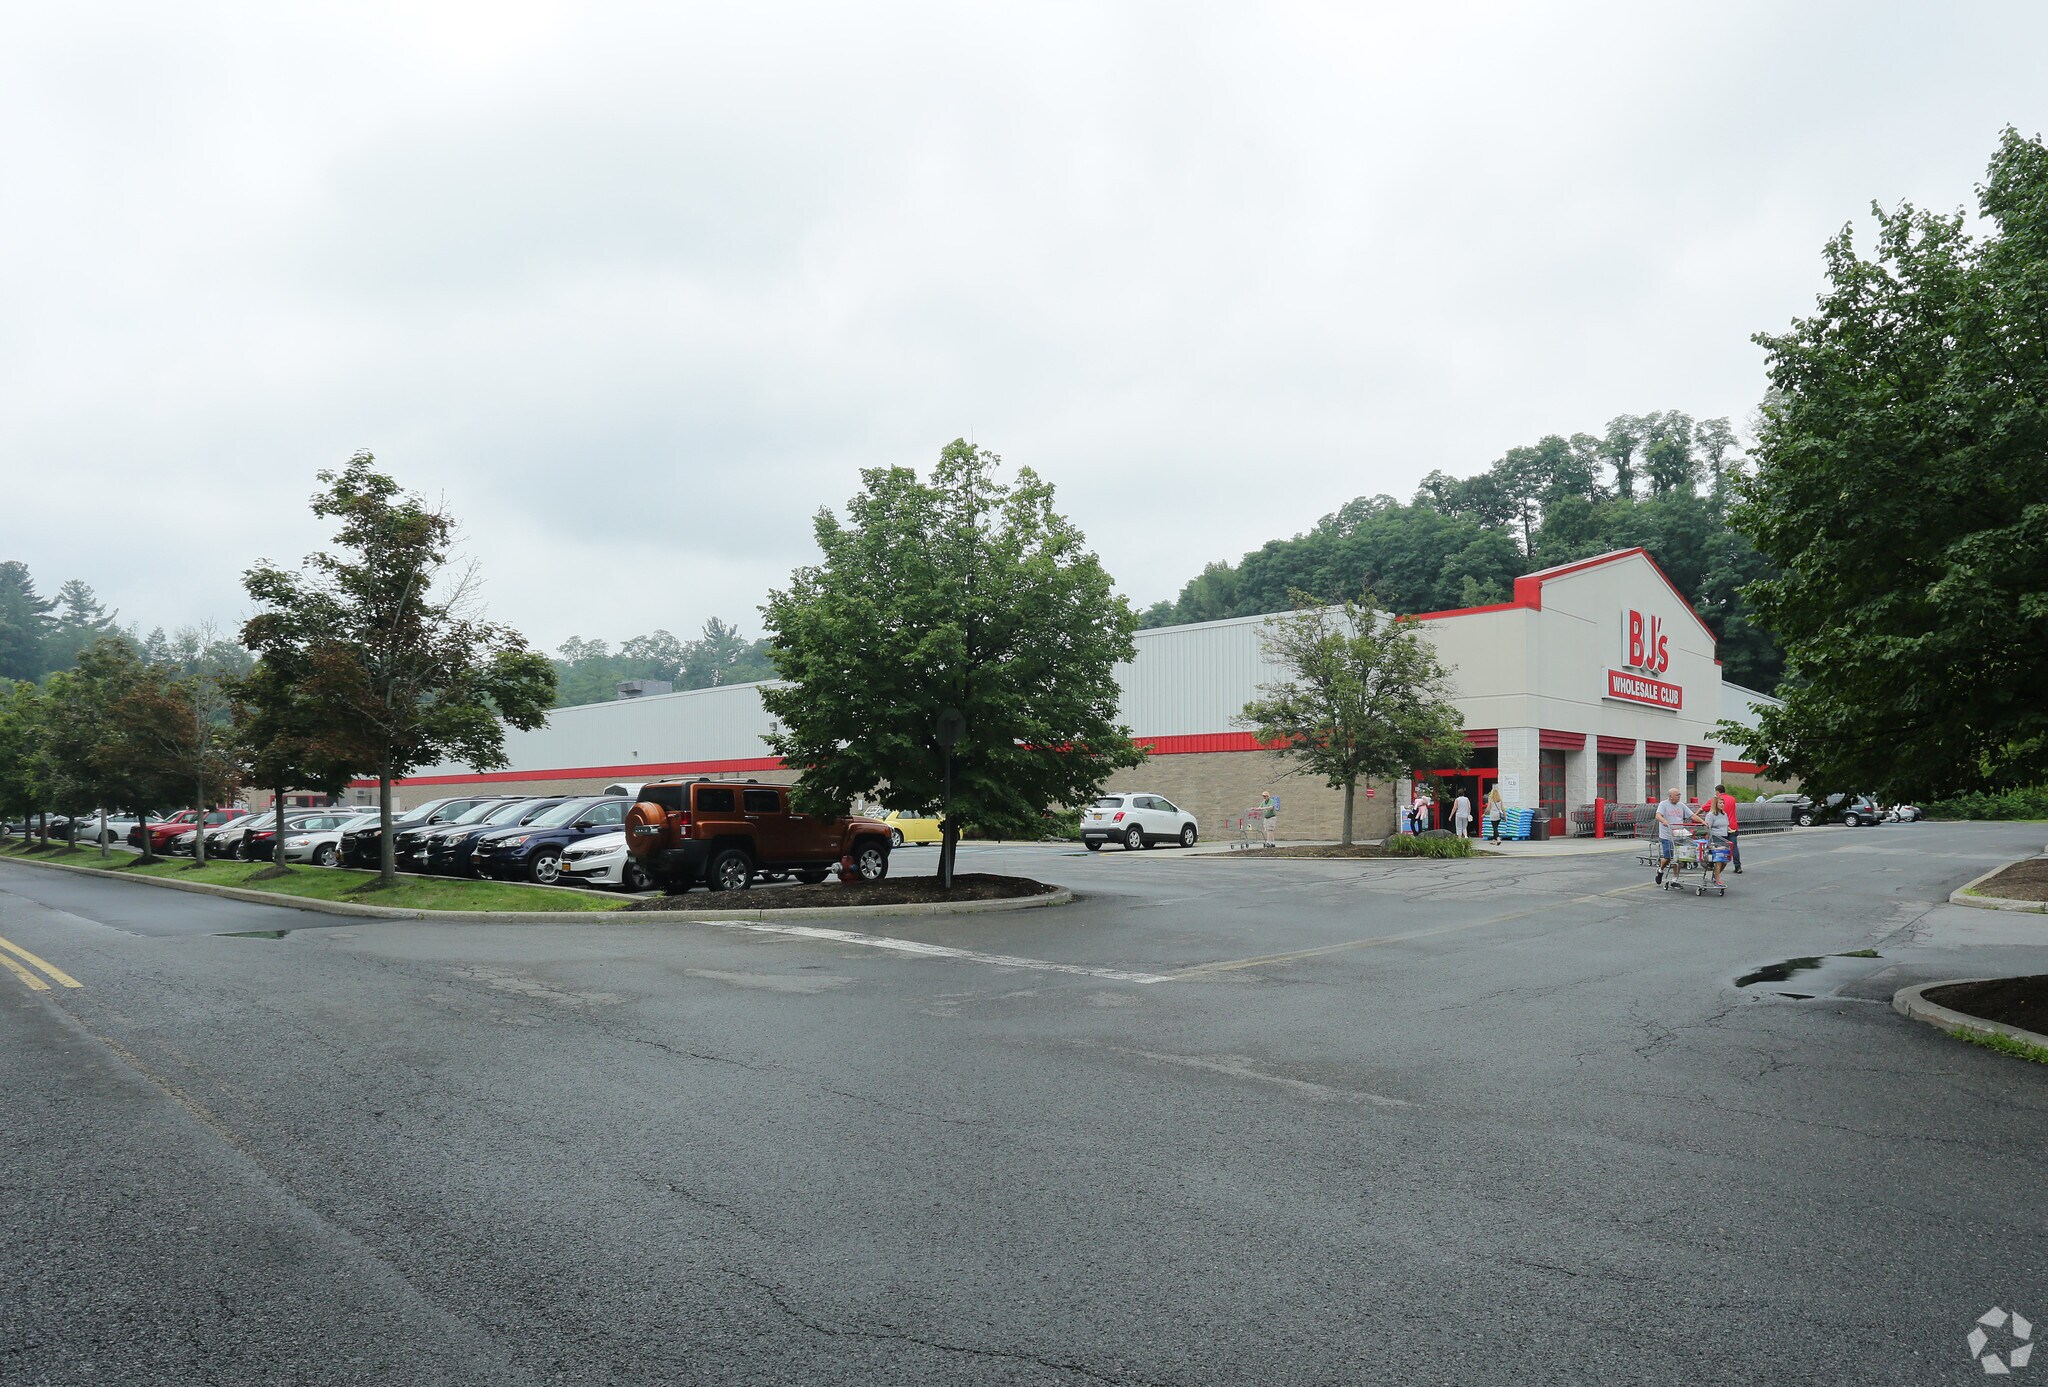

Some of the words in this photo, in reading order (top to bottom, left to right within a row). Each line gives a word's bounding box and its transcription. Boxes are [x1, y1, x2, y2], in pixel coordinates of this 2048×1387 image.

[1629, 609, 1669, 673] BJ's
[1612, 675, 1658, 700] WHOLESALE
[1660, 686, 1679, 705] CLUB
